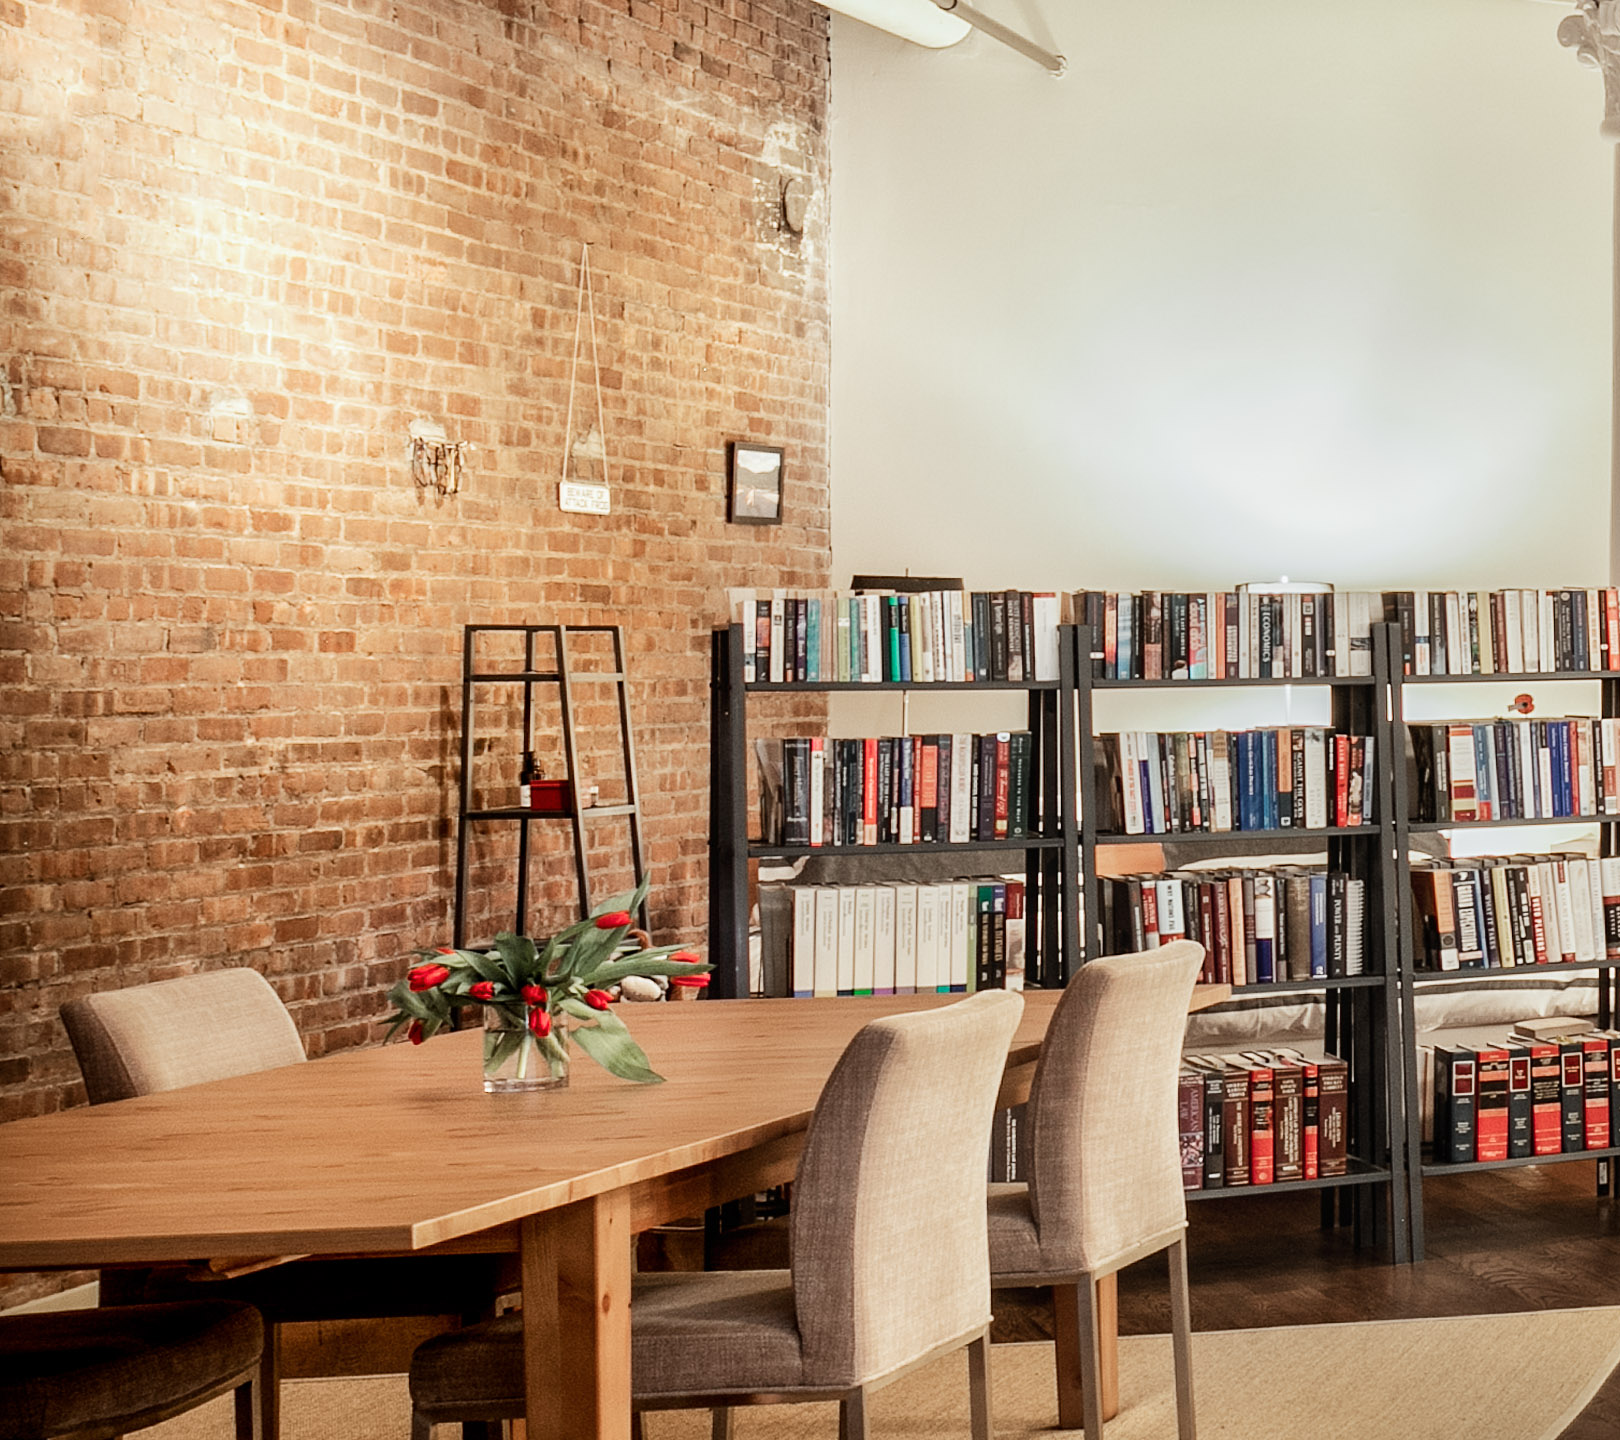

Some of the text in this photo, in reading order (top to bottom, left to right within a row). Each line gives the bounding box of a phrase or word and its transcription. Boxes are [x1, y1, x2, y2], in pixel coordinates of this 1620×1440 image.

[1262, 612, 1272, 664] ECONOMICS
[1334, 899, 1342, 924] POWER
[1532, 897, 1545, 952] VETO PLAYERS
[1334, 934, 1342, 961] PLENTY
[1180, 1101, 1189, 1119] LAW
[1189, 1087, 1200, 1133] AMERICAN
